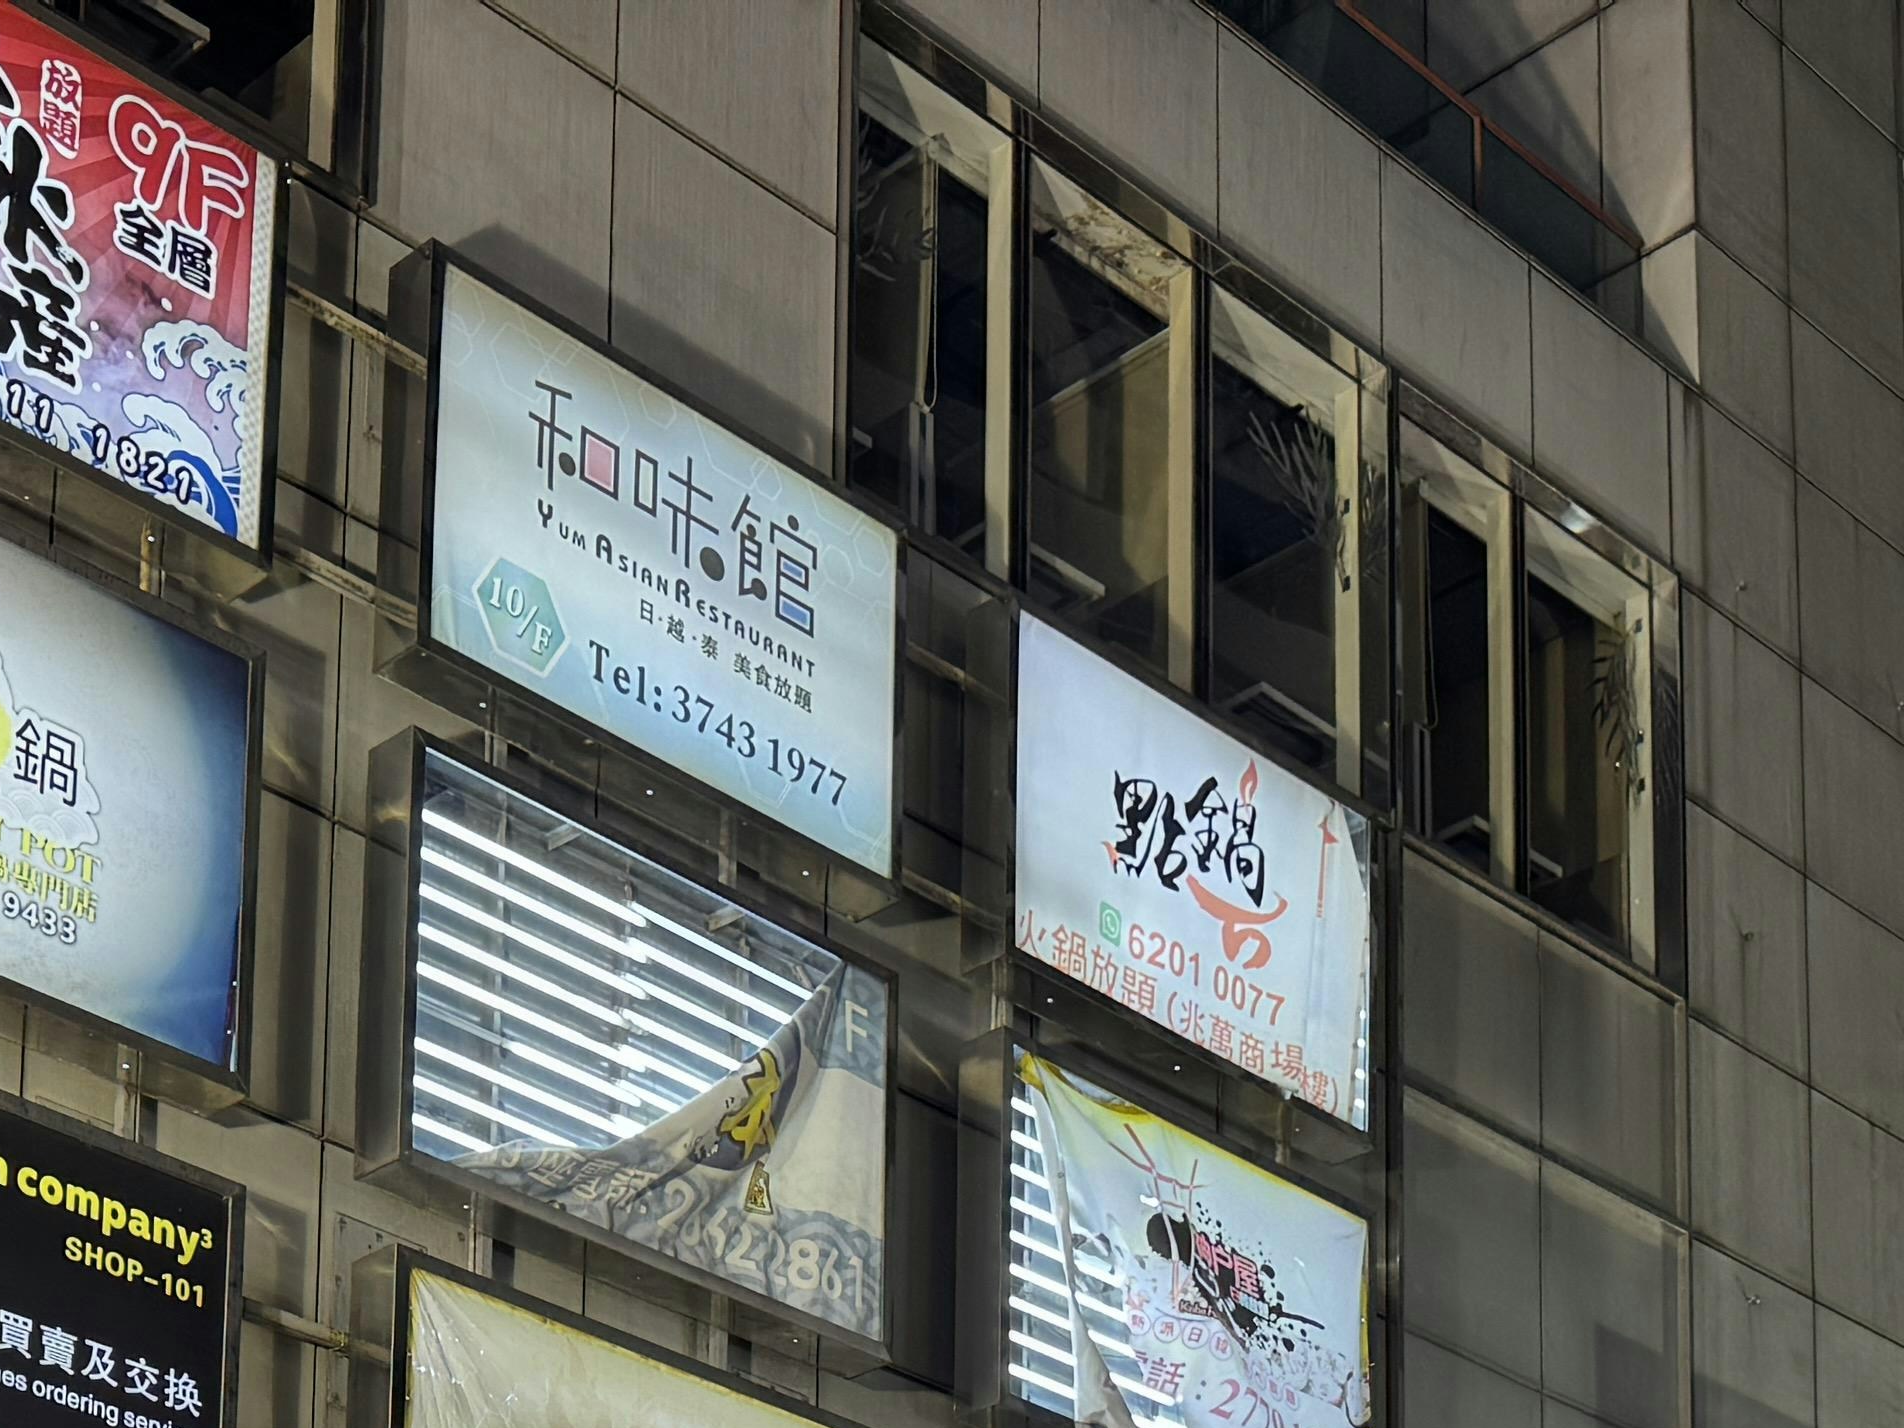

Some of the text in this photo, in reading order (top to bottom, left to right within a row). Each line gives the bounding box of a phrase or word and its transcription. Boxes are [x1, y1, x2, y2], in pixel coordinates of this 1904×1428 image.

[115, 204, 219, 299] 全層
[92, 426, 195, 505] 1821
[528, 379, 819, 639] 和味館
[489, 574, 554, 658] 10/F
[672, 686, 757, 761] 3743
[767, 736, 849, 808] 1977
[20, 826, 102, 885] POT
[2, 892, 78, 945] 9433
[1018, 909, 1159, 1017] 火鍋放題
[1127, 922, 1286, 1026] 6201 0077
[63, 1237, 207, 1309] SHOP-101
[31, 1371, 120, 1428] ordering
